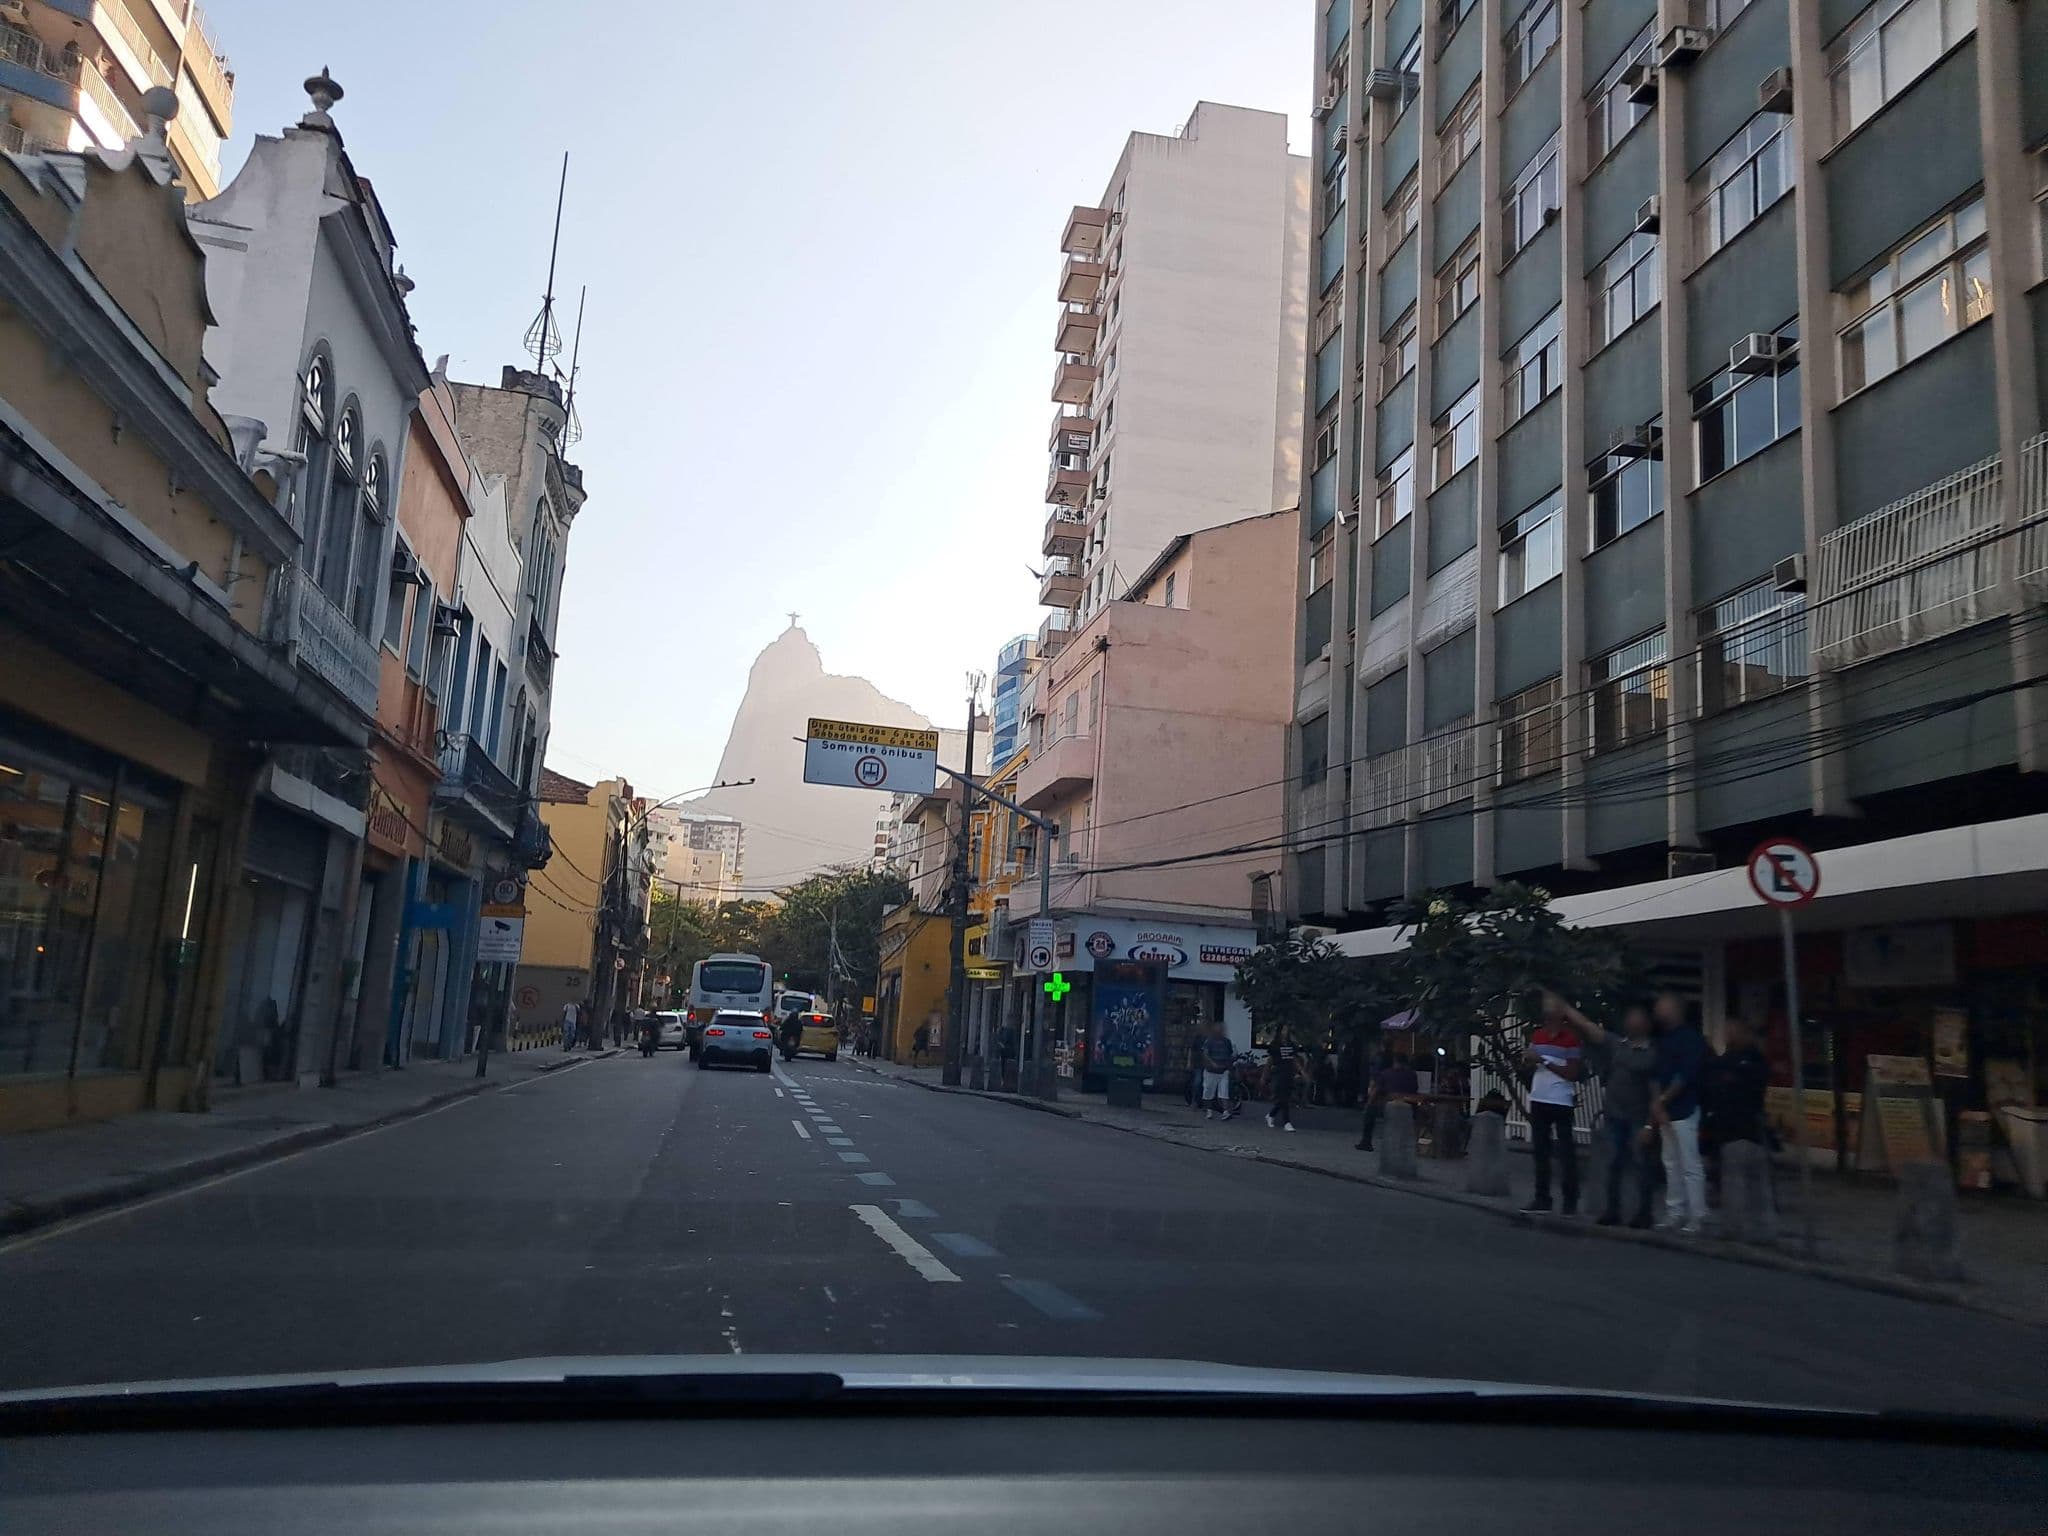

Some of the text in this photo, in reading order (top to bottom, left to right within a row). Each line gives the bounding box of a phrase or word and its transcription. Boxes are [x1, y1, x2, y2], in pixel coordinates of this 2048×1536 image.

[811, 720, 834, 730] Dias
[869, 727, 886, 735] das
[893, 730, 900, 738] 6
[919, 732, 935, 741] 21h
[814, 729, 857, 740] Sábados
[861, 734, 879, 743] das
[914, 740, 932, 748] 14h
[822, 740, 923, 759] Somente ônibus
[1139, 950, 1176, 962] CRISTAL
[1201, 945, 1250, 956] ENTREGAS
